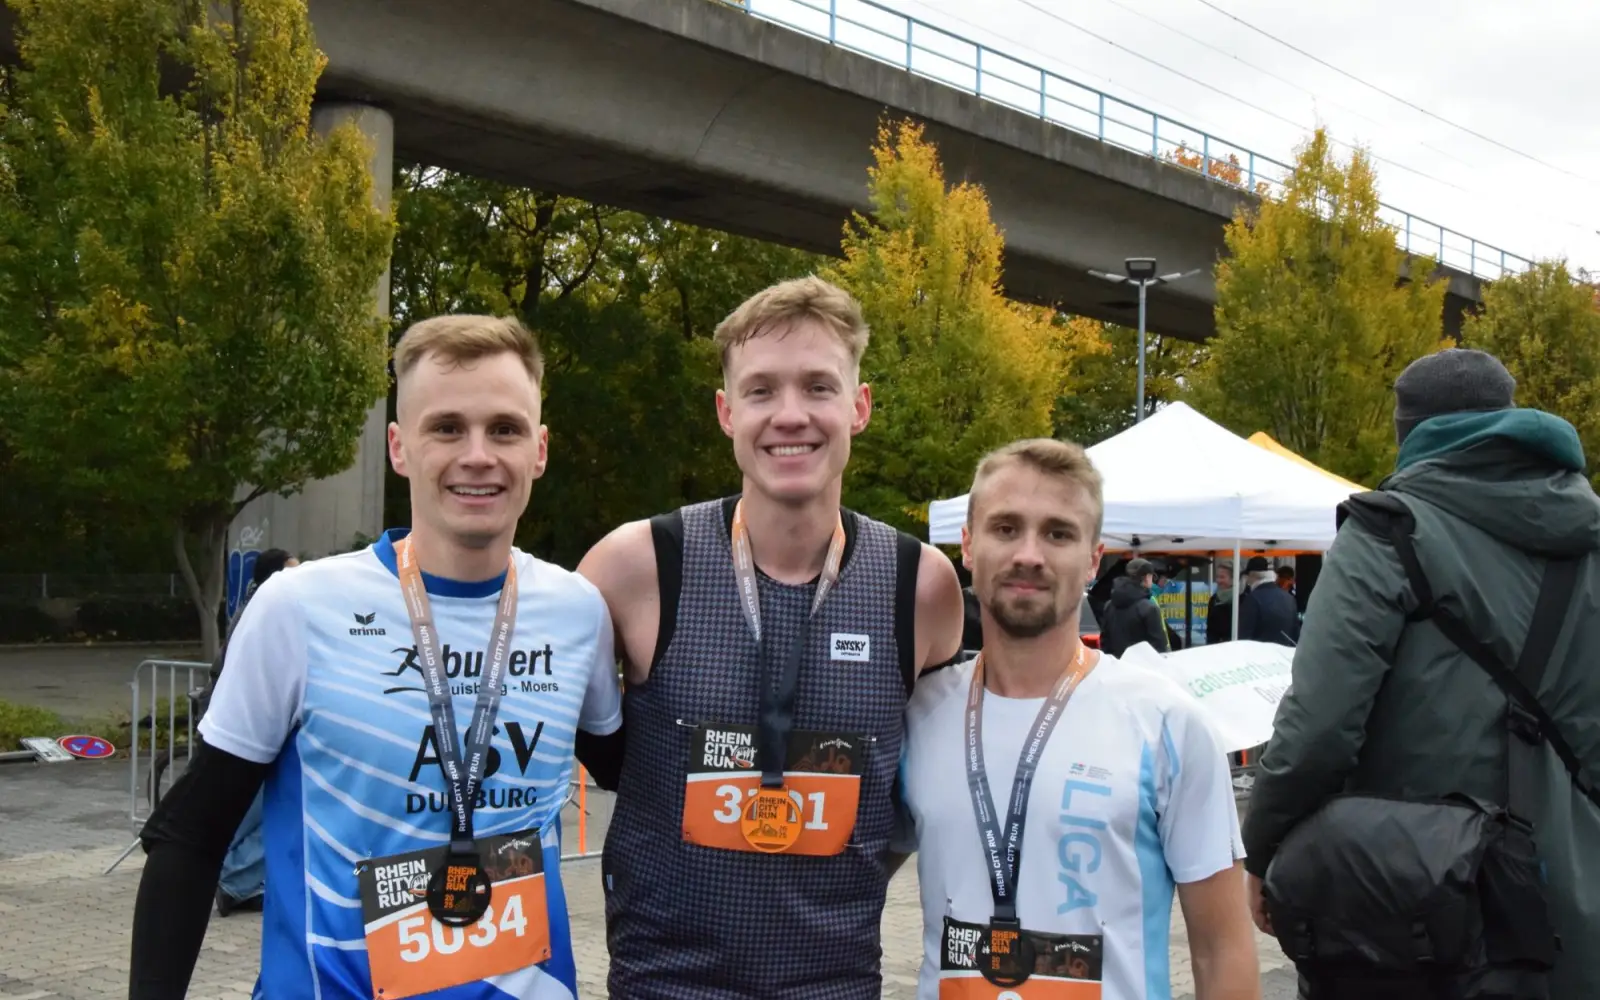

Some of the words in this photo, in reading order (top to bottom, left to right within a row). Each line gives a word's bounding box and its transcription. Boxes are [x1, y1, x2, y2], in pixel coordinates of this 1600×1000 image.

[349, 626, 386, 636] erima
[419, 625, 431, 645] RUN
[498, 622, 509, 641] RUN
[494, 641, 505, 662] CITY
[835, 639, 866, 652] SAYSKY
[424, 646, 435, 667] CITY
[442, 643, 553, 679] buert
[429, 667, 442, 696] RHEIN
[488, 661, 500, 689] RHEIN
[521, 680, 559, 693] Moers
[705, 729, 752, 747] RHEIN
[1025, 738, 1040, 763] RHEIN
[1036, 720, 1049, 738] CITY
[1044, 704, 1058, 721] RUN
[704, 741, 737, 756] CITY
[447, 760, 459, 780] RUN
[469, 752, 481, 773] RUN
[703, 754, 735, 770] RUN
[453, 780, 463, 803] CITY
[759, 796, 787, 804] RHEIN
[455, 803, 466, 832] RHEIN
[759, 811, 777, 819] RUN
[985, 829, 997, 848] RUN
[1009, 822, 1020, 842] RUN
[1006, 842, 1016, 863] CITY
[1057, 779, 1112, 915] LIGA
[989, 848, 1001, 869] CITY
[374, 859, 426, 881] RHEIN
[446, 875, 469, 883] CITY
[447, 866, 477, 876] RHEIN
[376, 876, 414, 894] CITY
[446, 882, 467, 891] RUN
[994, 869, 1006, 896] RHEIN
[378, 891, 415, 909] RUN
[398, 894, 528, 963] 5034
[991, 930, 1018, 940] RHEIN
[947, 939, 975, 954] CITY
[991, 938, 1011, 947] CITY
[991, 945, 1010, 954] RUN
[948, 951, 972, 967] RUN
